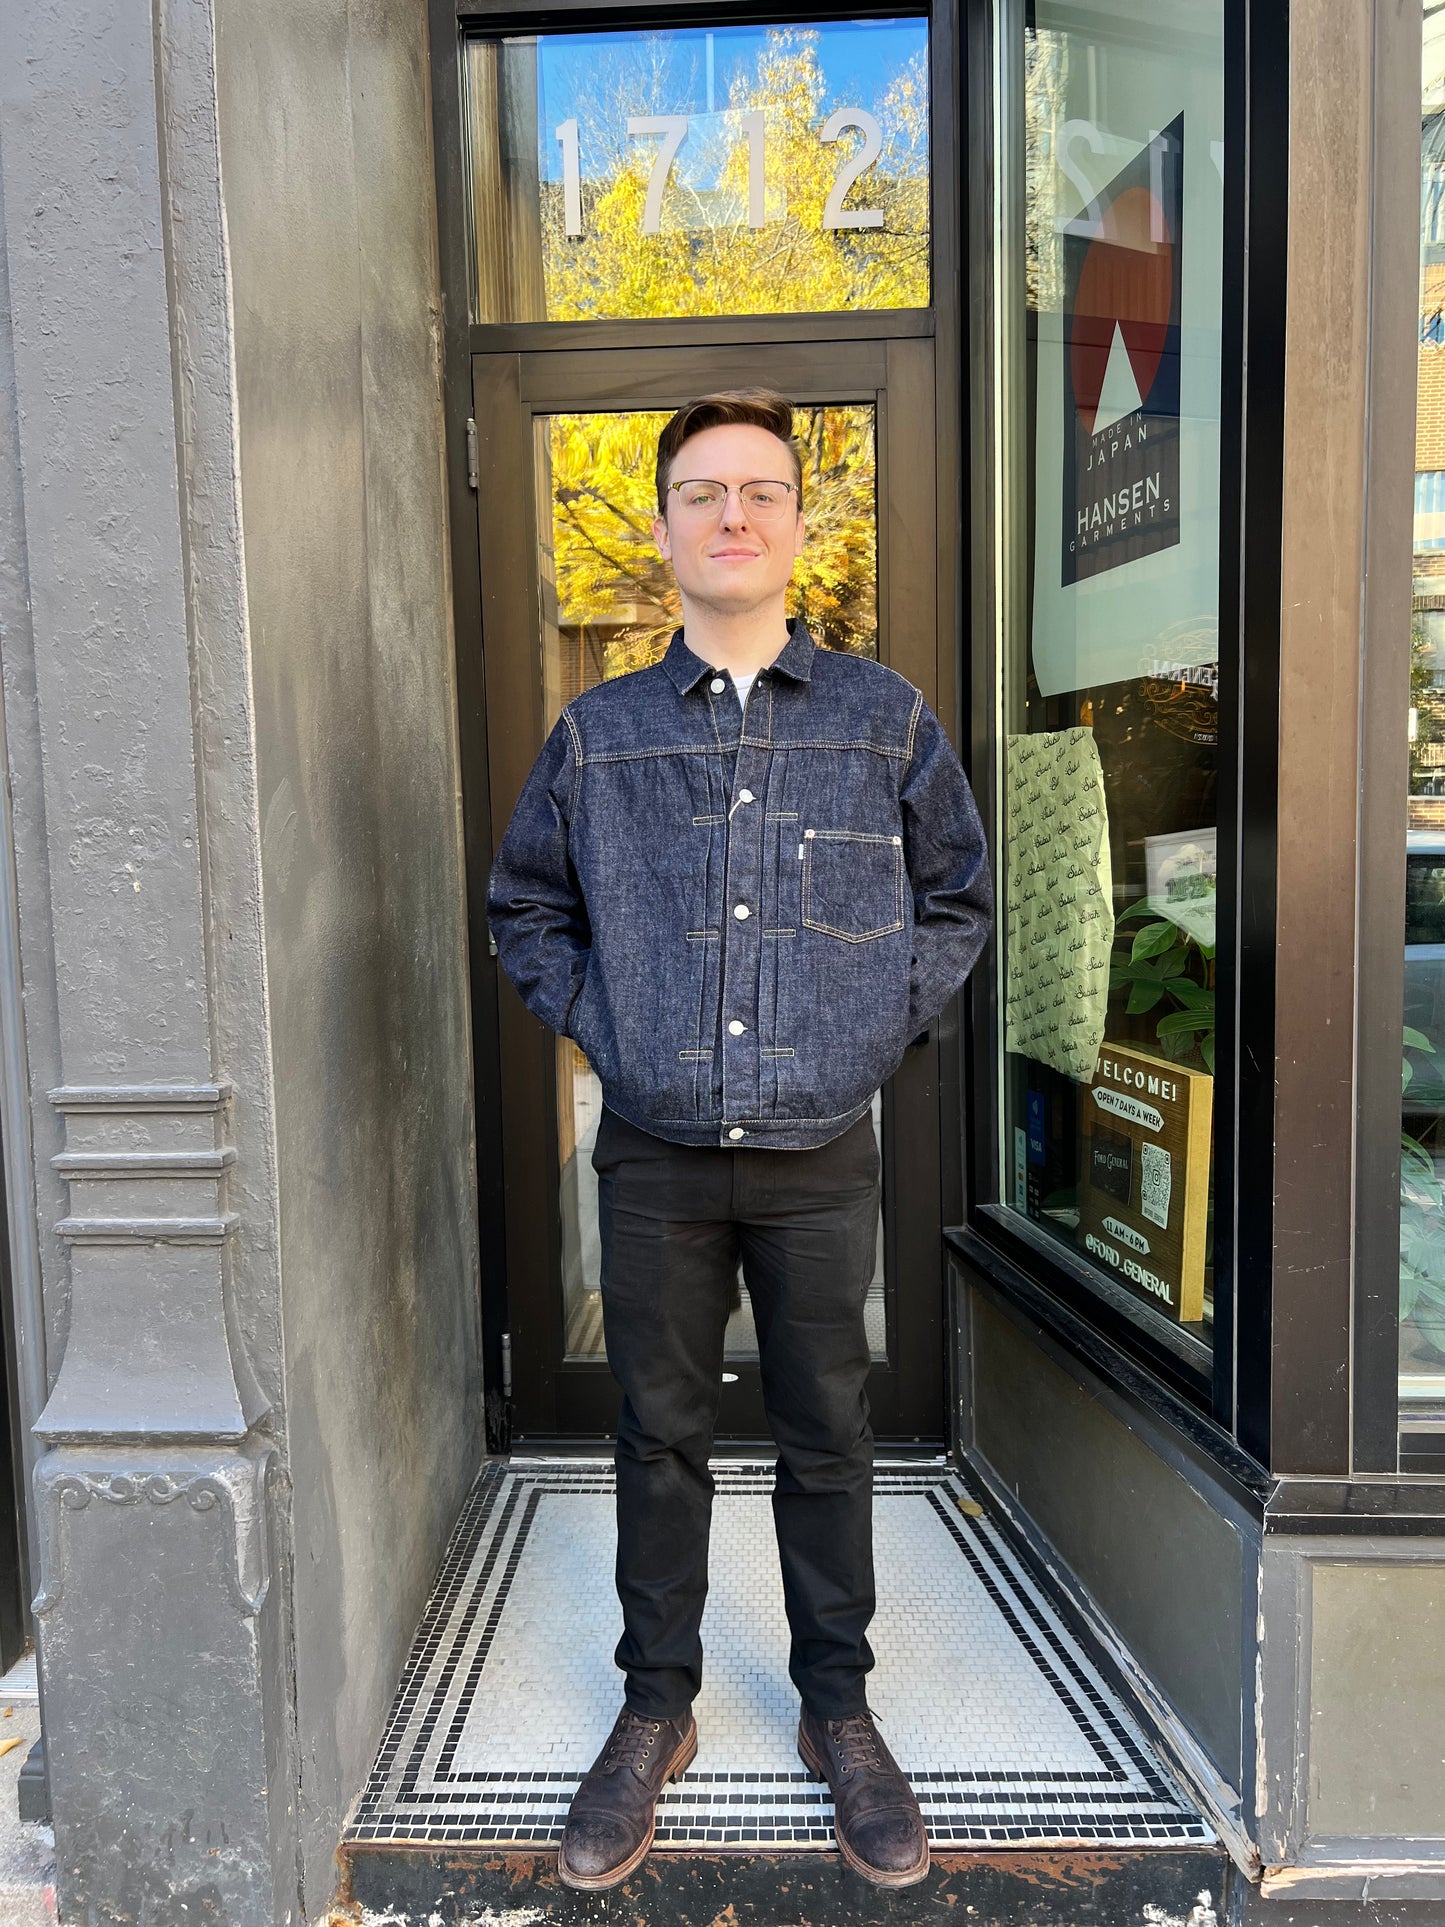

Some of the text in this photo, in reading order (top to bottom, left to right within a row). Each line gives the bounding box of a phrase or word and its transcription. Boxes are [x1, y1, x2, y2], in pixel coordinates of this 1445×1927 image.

[556, 108, 884, 236] 1712
[1087, 424, 1147, 471] JAPAN
[1092, 411, 1143, 449] MADE IN
[1069, 499, 1170, 552] GARMENTS
[1077, 472, 1160, 535] HANSEN
[1097, 1091, 1161, 1127] OPEN 7 DAYS A WEEK
[1106, 1220, 1113, 1233] 11
[1114, 1225, 1125, 1239] AM
[1130, 1233, 1134, 1245] 6
[1134, 1236, 1145, 1252] PM
